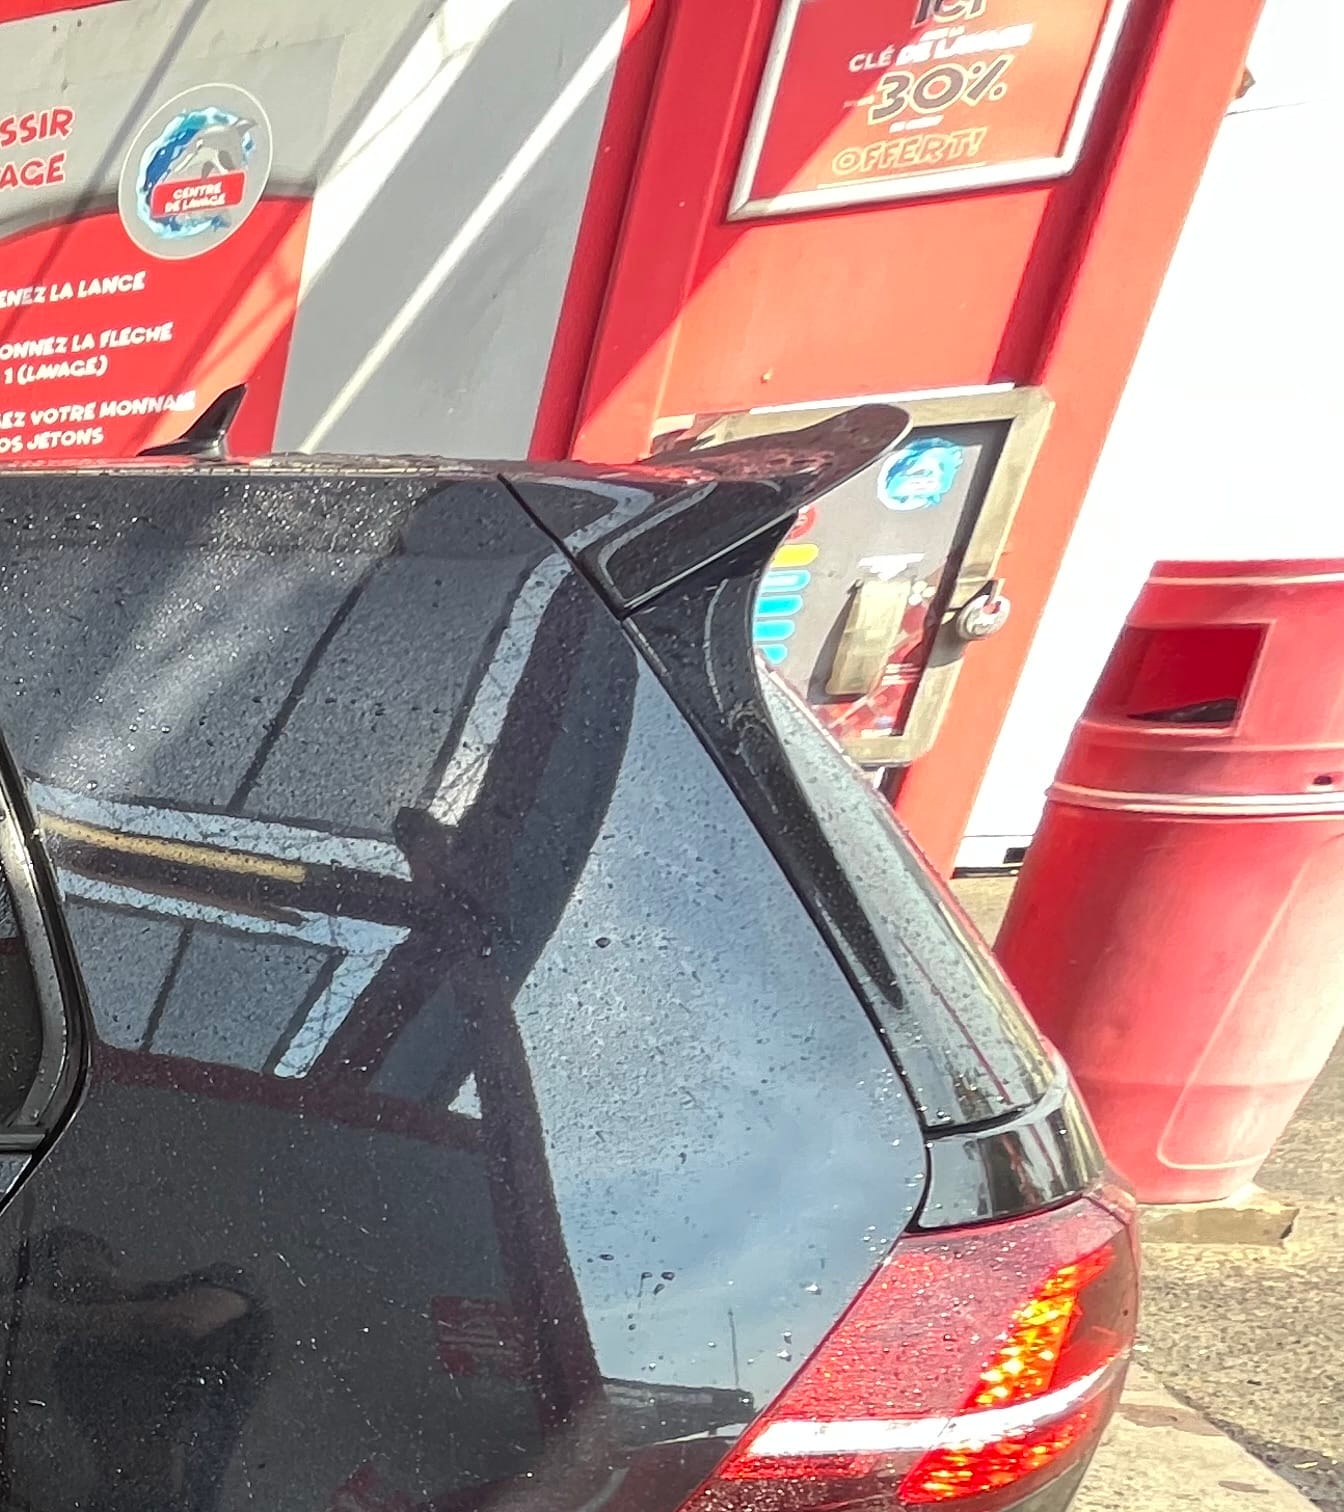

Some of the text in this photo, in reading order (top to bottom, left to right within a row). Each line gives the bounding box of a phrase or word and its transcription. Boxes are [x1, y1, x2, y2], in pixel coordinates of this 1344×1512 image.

[849, 45, 895, 72] CLÉ
[832, 127, 987, 175] OFFERT!
[173, 182, 222, 199] CENTRE
[165, 201, 180, 213] DE
[49, 283, 74, 302] LA
[77, 271, 147, 298] LANCE
[71, 333, 95, 352] LA
[3, 366, 13, 385] 1
[17, 354, 108, 385] (LAVAGE)
[30, 402, 95, 426] VOTRE
[27, 427, 104, 450] JETONS
